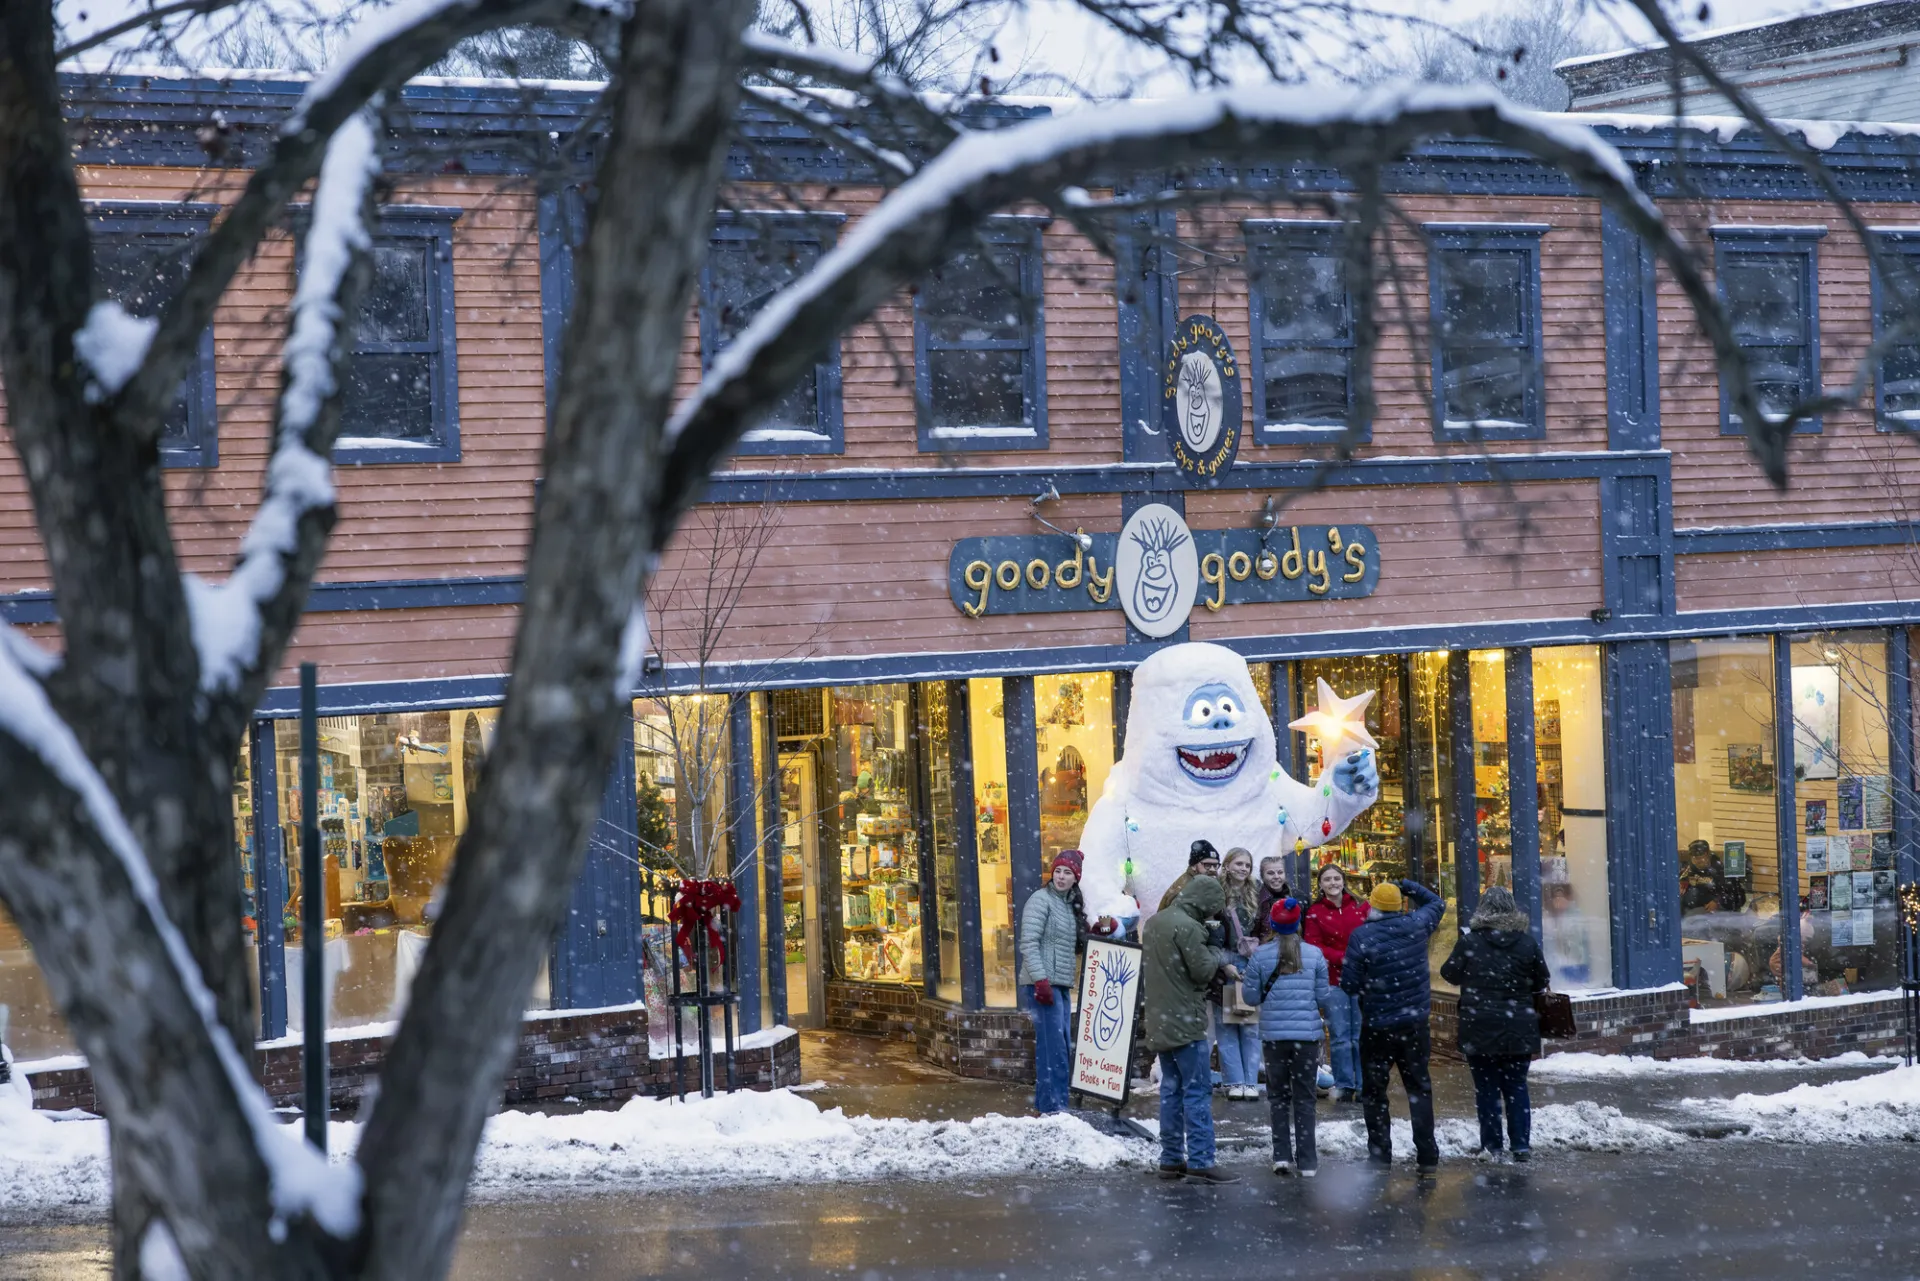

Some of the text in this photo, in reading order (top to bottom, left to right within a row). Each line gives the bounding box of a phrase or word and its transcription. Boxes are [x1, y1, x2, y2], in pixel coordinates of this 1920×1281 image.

[1165, 323, 1235, 399] goody goody's
[1174, 427, 1235, 477] toys & games
[963, 526, 1366, 617] goody goody's
[1082, 949, 1100, 1043] goody goody's
[1079, 1052, 1123, 1075] Toys Games
[1080, 1071, 1121, 1092] Books Fun
